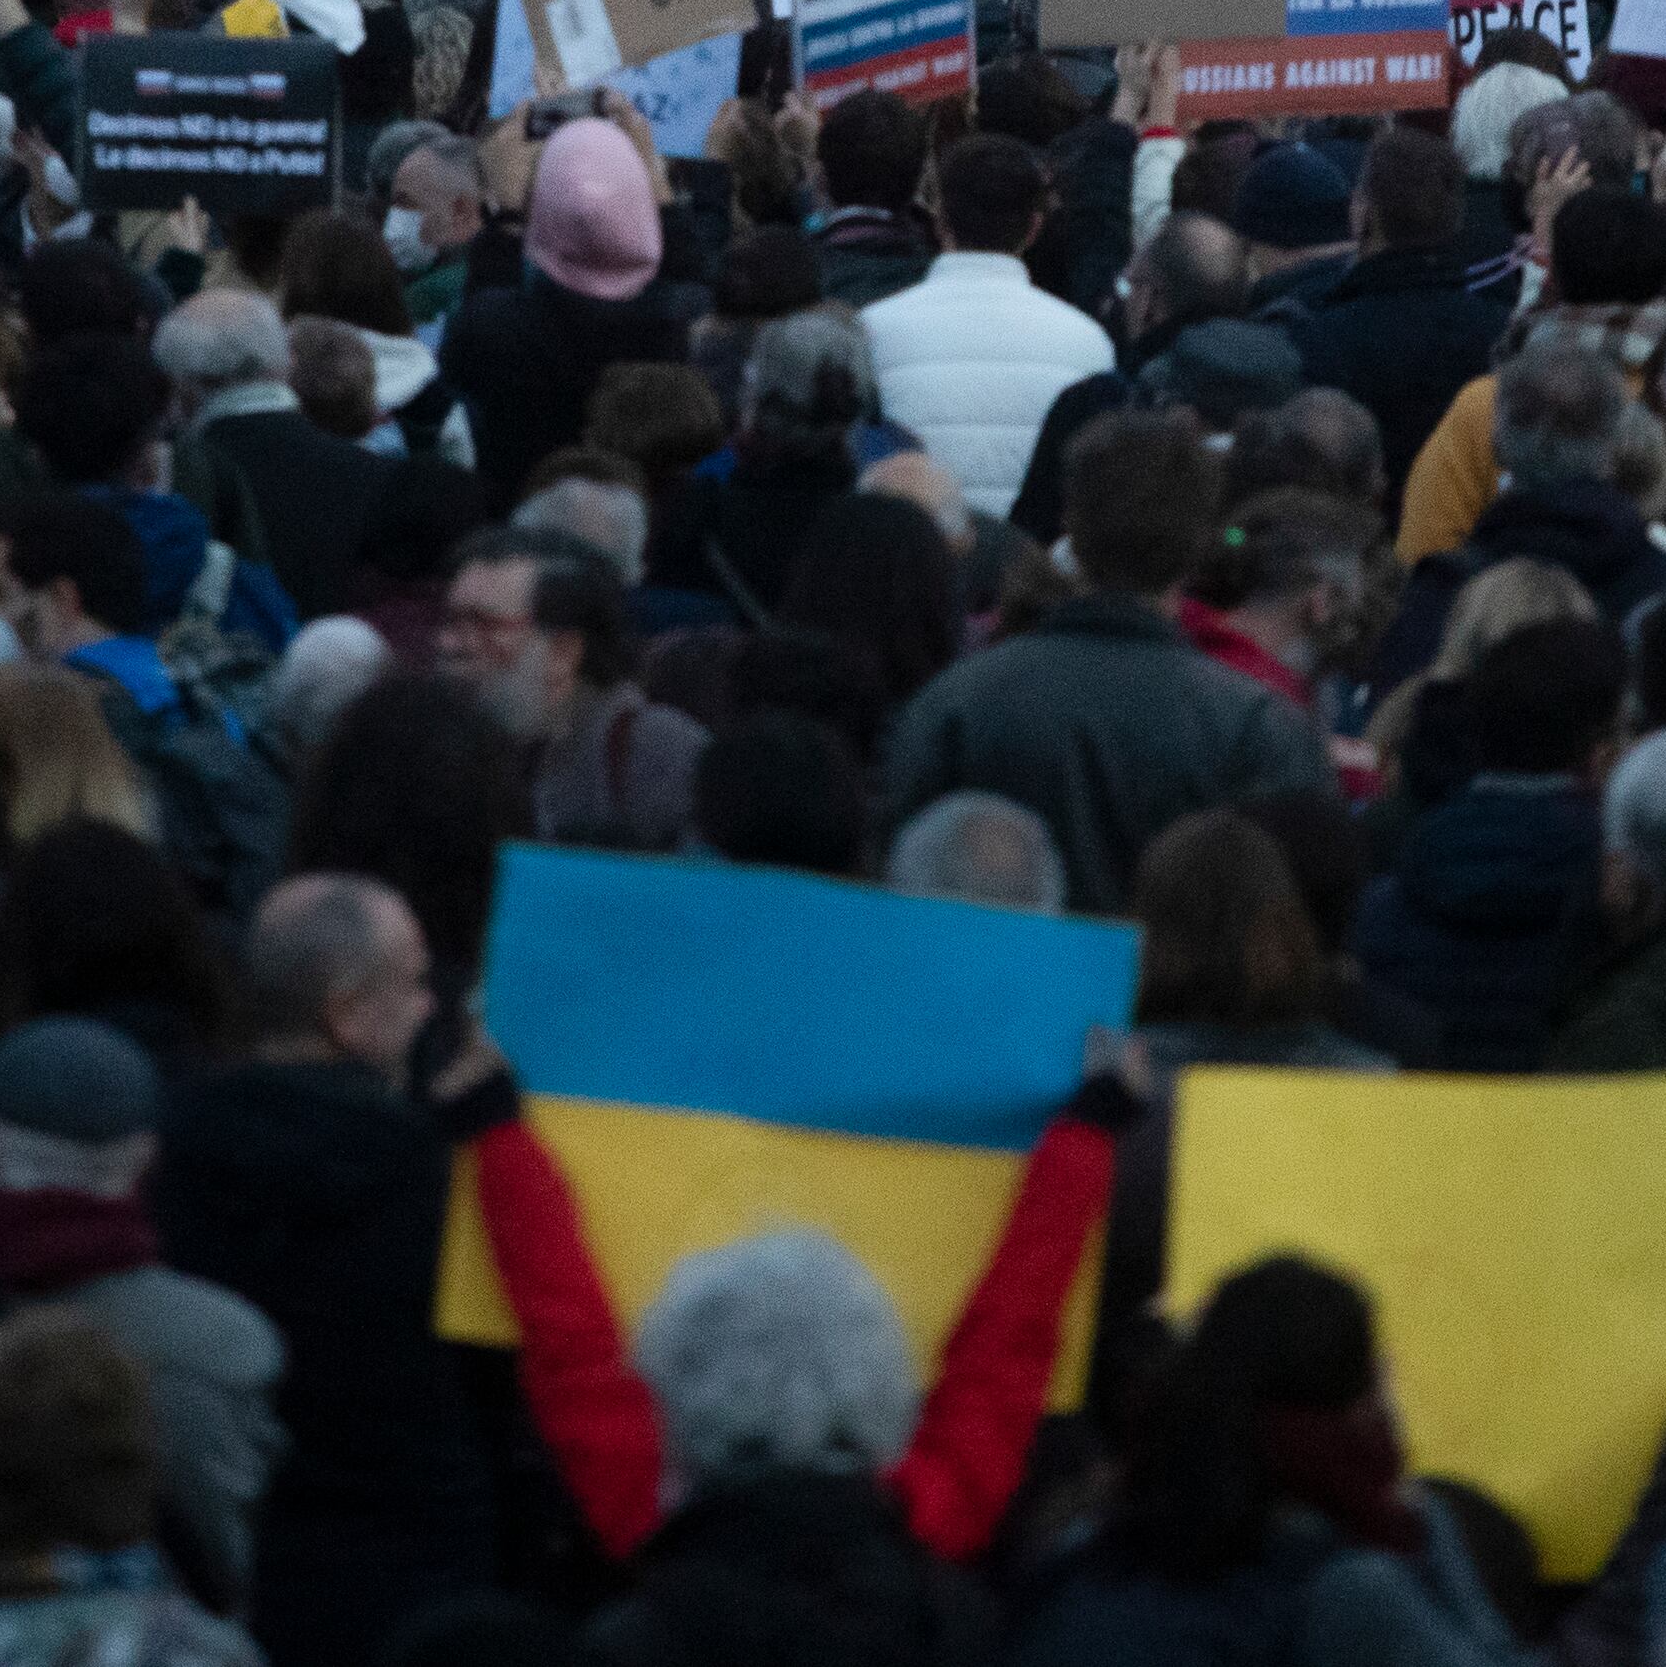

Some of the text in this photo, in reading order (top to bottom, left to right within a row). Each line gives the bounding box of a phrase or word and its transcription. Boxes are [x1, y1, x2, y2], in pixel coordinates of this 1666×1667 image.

[1182, 52, 1443, 94] USSIANS AGAINST WAR!
